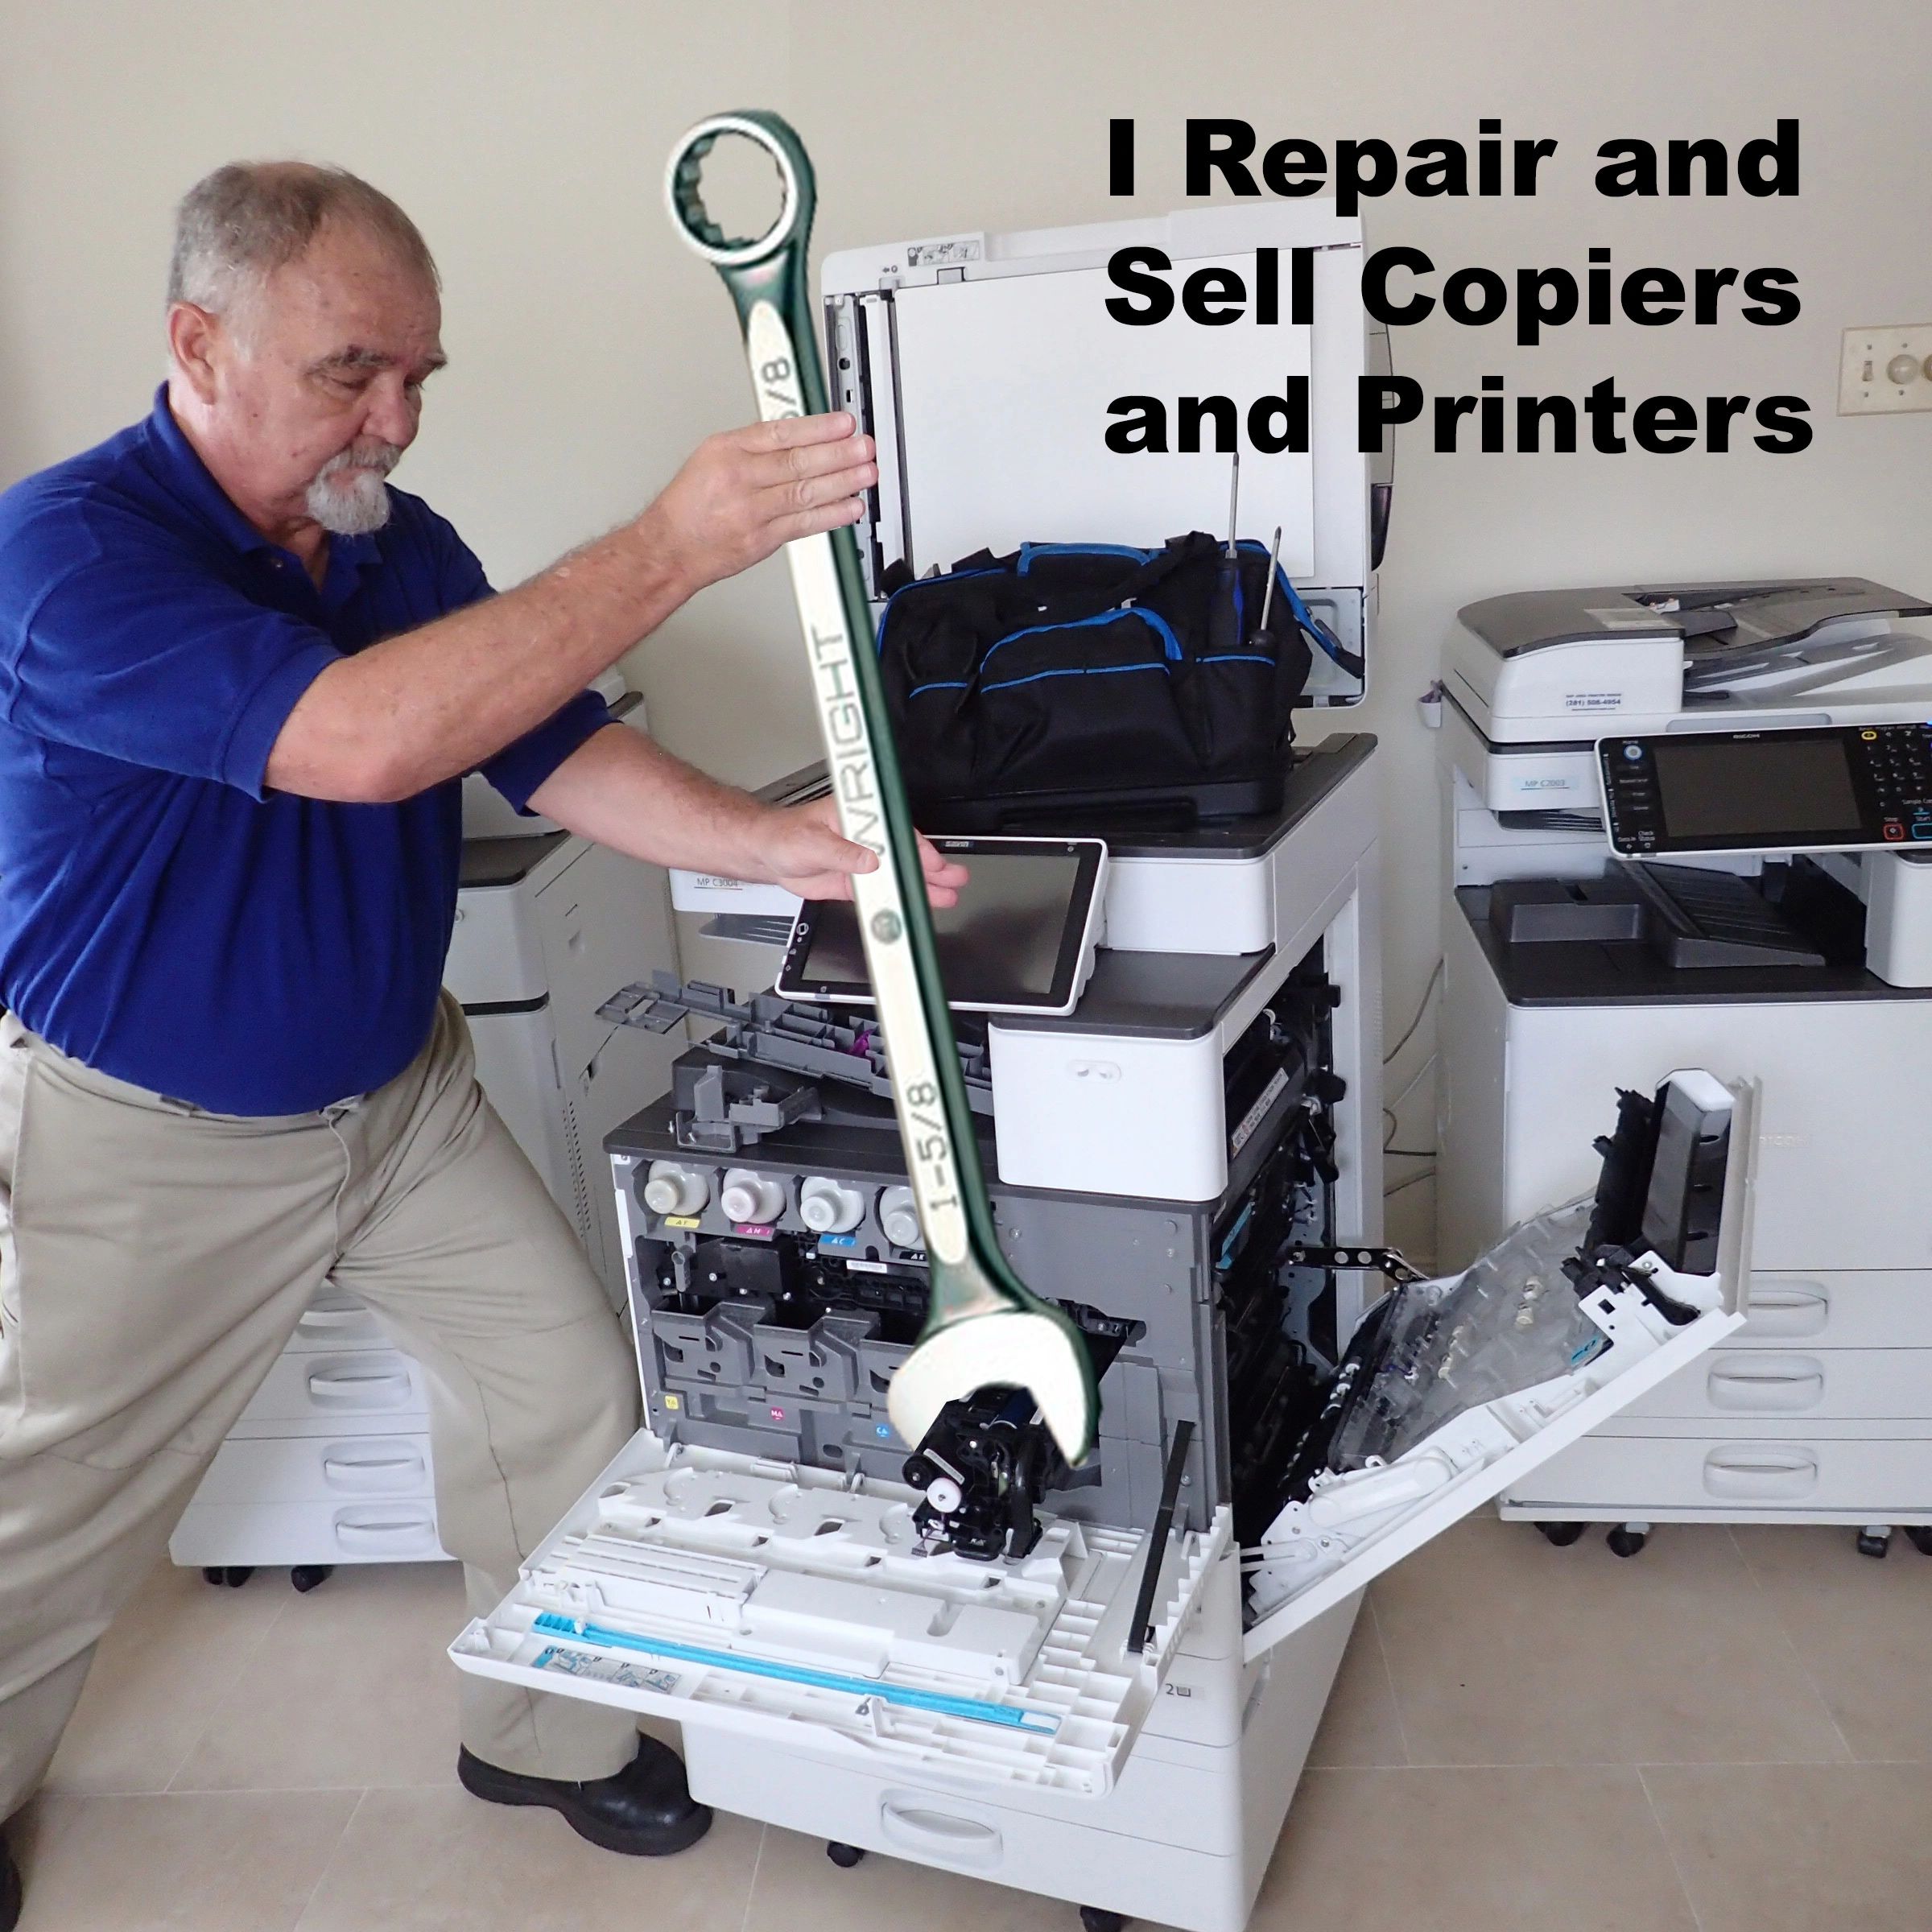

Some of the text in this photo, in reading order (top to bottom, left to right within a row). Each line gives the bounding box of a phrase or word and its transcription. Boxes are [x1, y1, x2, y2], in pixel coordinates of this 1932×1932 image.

[811, 623, 886, 857] WRIGHT
[697, 877, 709, 886] MP
[906, 1081, 959, 1211] 1-5/8
[1165, 1682, 1174, 1695] 2
